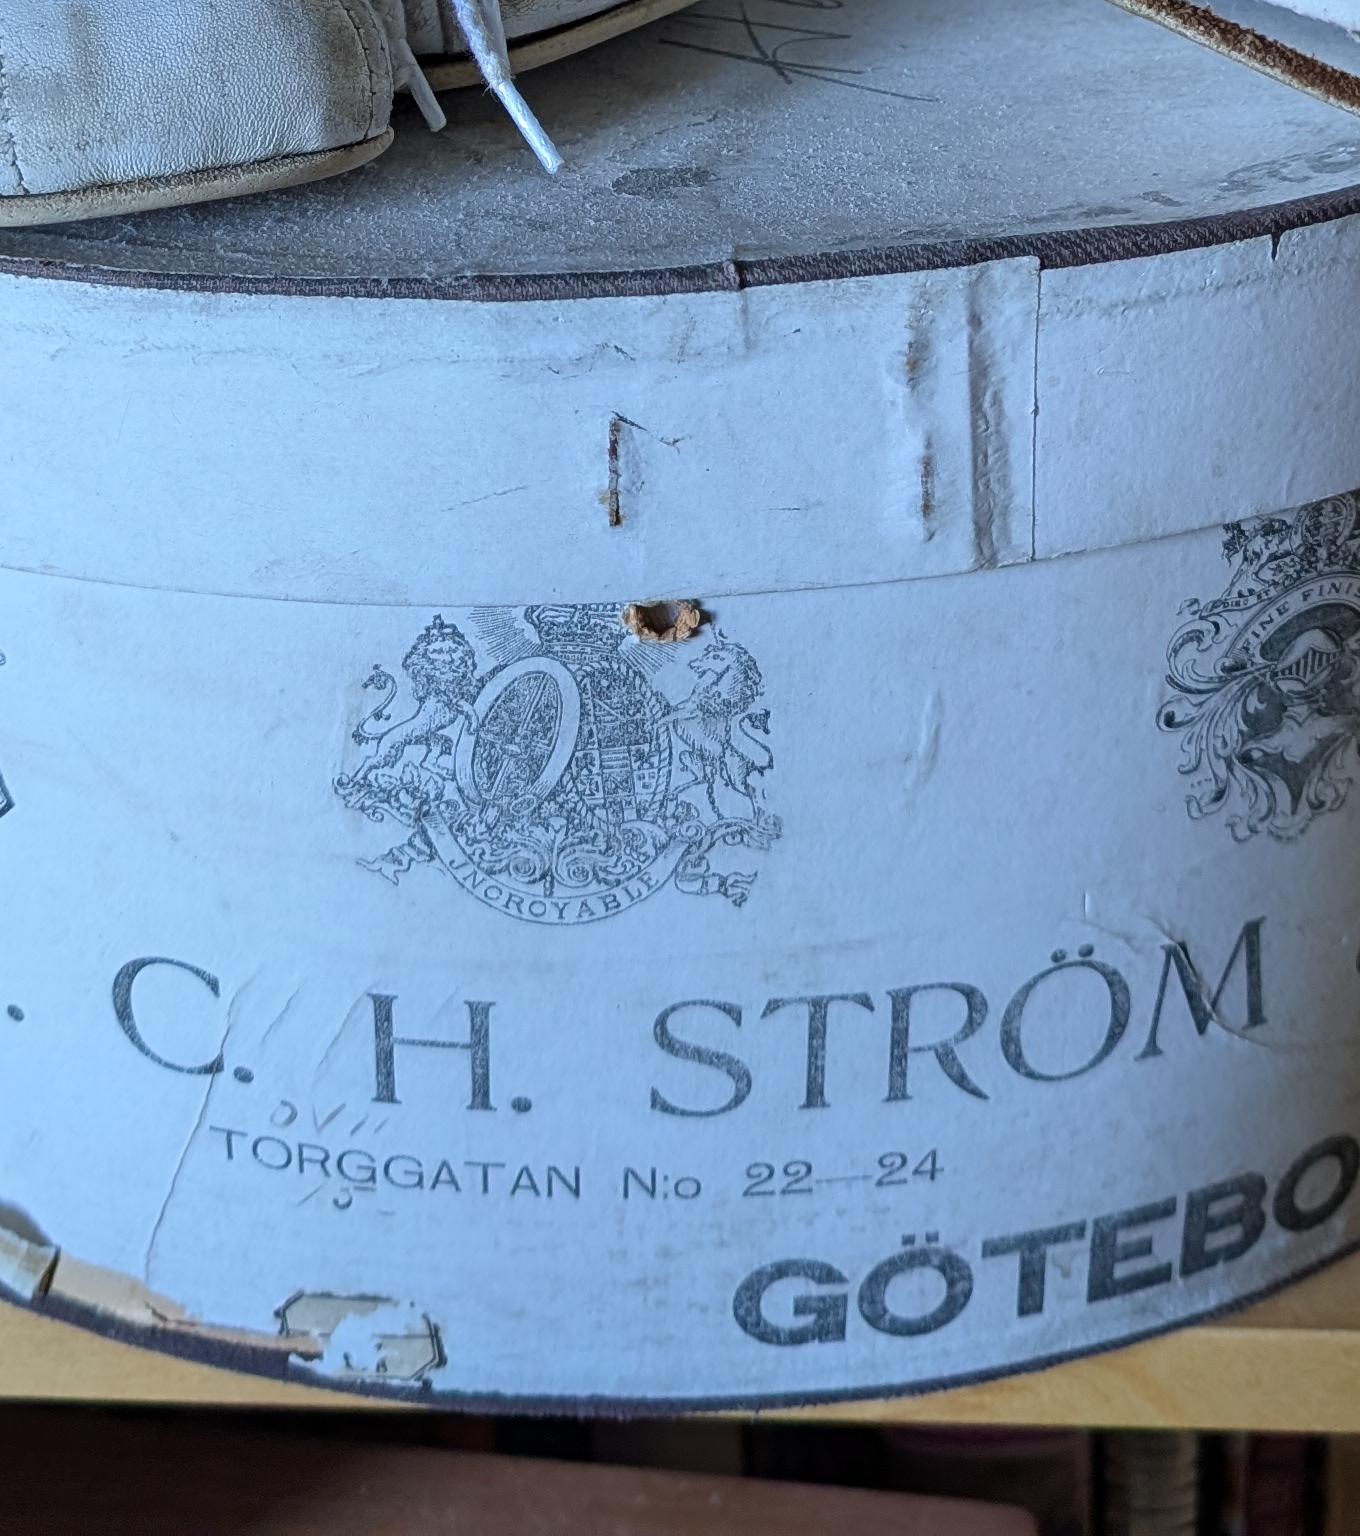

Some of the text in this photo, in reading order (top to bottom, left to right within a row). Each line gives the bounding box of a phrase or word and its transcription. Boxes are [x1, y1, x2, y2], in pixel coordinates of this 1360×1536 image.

[1242, 601, 1290, 653] FINE
[113, 956, 256, 1084] C.
[366, 992, 534, 1114] H.
[649, 917, 1268, 1118] STRÖM
[208, 1124, 582, 1200] TORGGATAN
[621, 1166, 703, 1199] N:o
